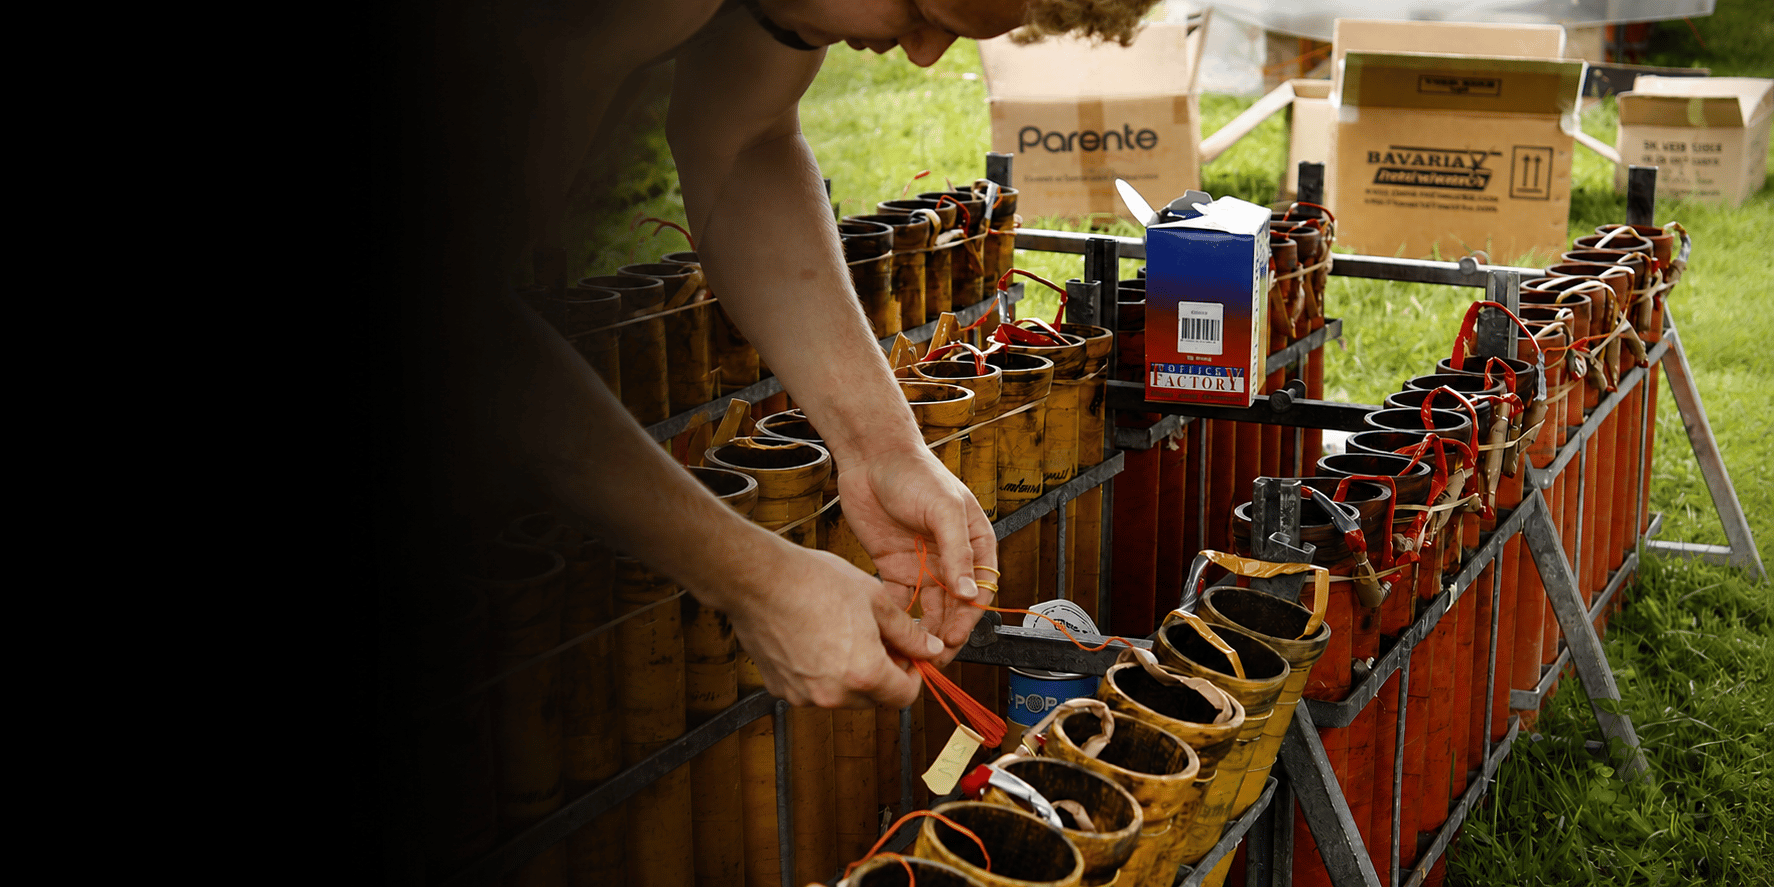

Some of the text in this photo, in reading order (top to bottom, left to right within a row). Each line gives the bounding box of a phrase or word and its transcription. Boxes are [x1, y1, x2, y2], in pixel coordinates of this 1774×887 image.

[1018, 123, 1158, 154] Parente
[1367, 151, 1466, 169] BAVARIA
[1152, 364, 1244, 392] FACTORY
